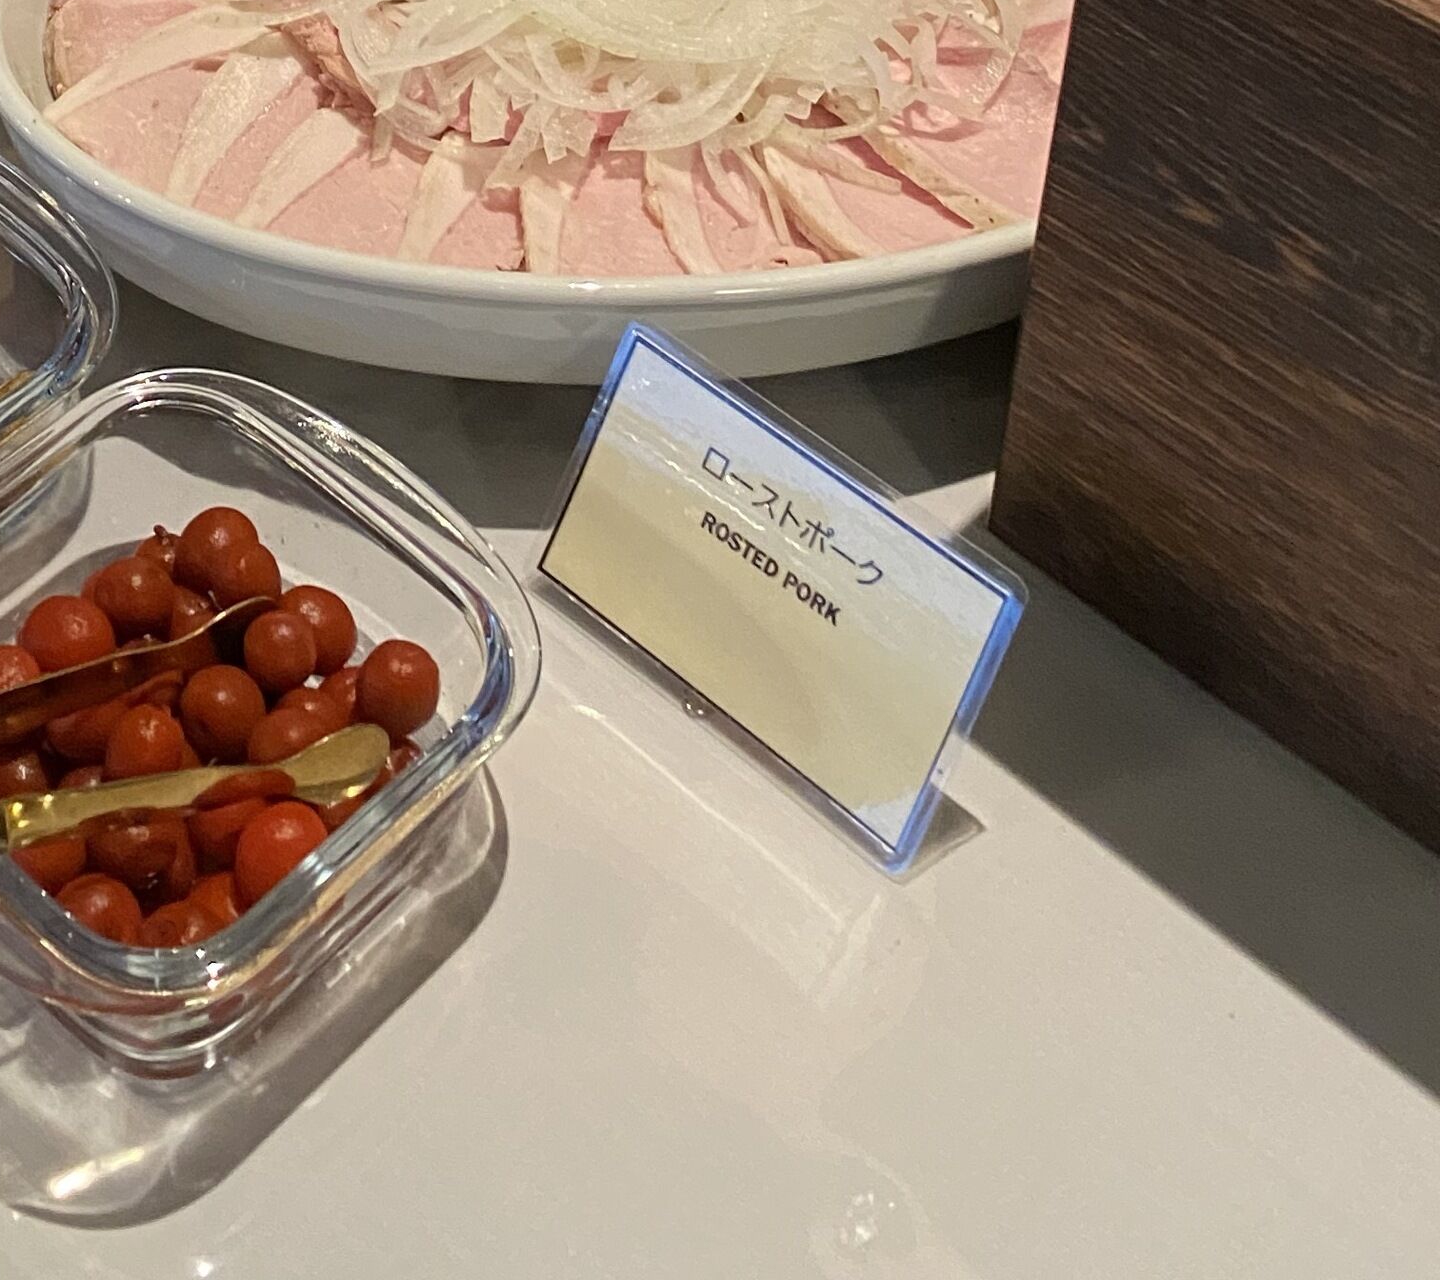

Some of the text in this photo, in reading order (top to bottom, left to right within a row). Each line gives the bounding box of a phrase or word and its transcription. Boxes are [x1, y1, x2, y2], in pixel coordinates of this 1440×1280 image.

[700, 510, 842, 627] ROSTED PORK
[701, 446, 884, 586] ローストポーク
